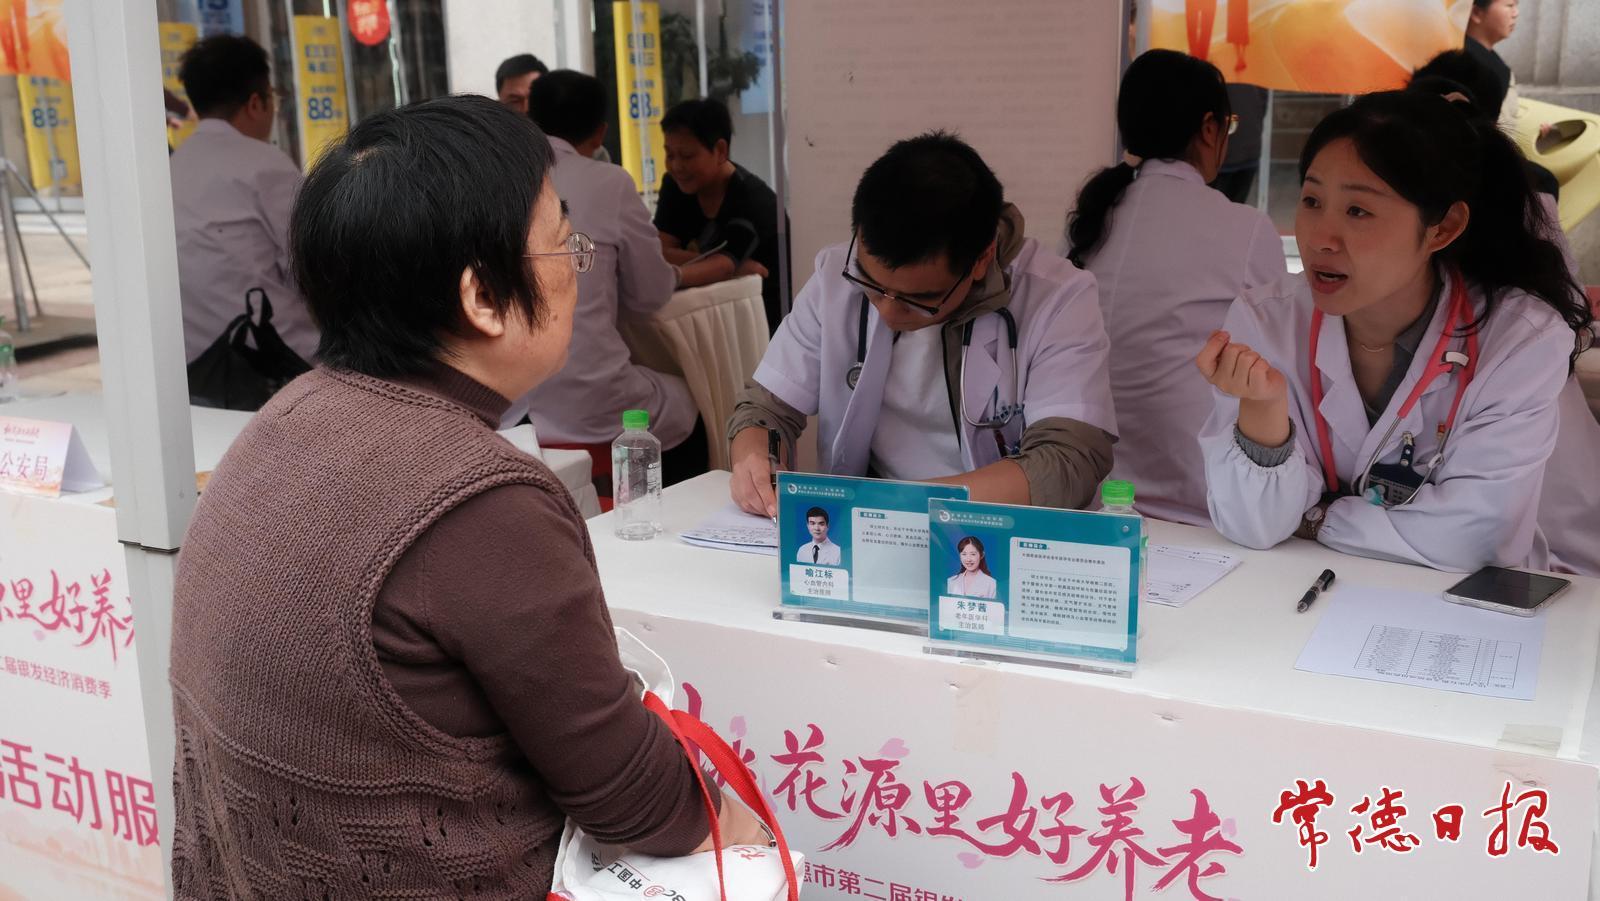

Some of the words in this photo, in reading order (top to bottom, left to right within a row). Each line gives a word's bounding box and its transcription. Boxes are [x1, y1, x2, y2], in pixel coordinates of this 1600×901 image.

[0, 451, 48, 481] 公安局
[0, 655, 112, 700] 届银发经济消费季
